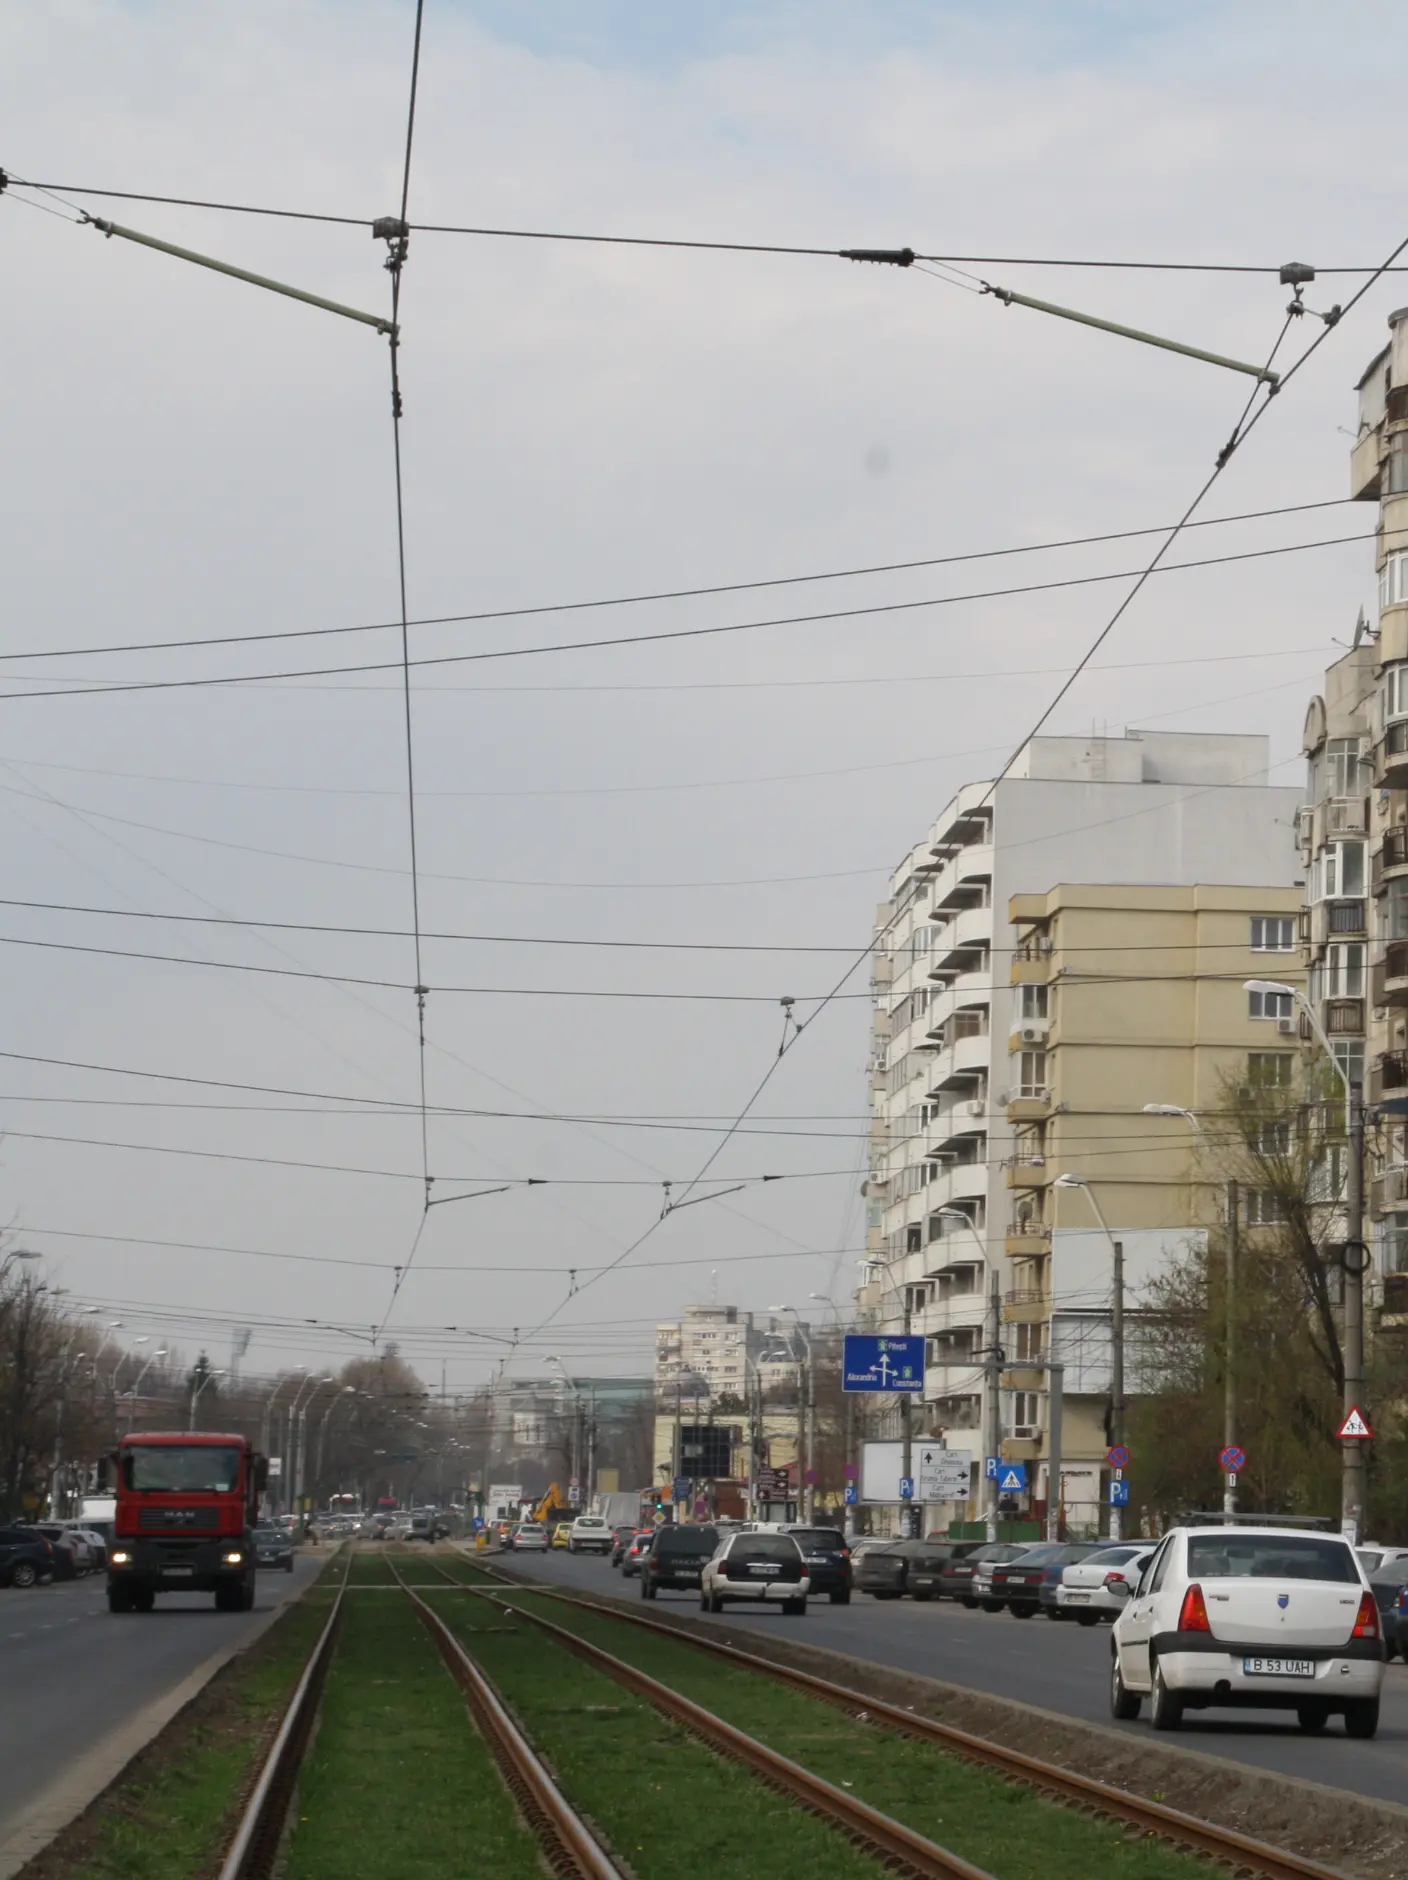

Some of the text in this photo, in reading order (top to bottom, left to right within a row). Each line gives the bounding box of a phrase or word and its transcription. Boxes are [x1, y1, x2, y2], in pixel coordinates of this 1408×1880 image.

[987, 1459, 996, 1476] P
[1110, 1482, 1121, 1503] P
[1253, 1659, 1310, 1674] B 53 UAH
